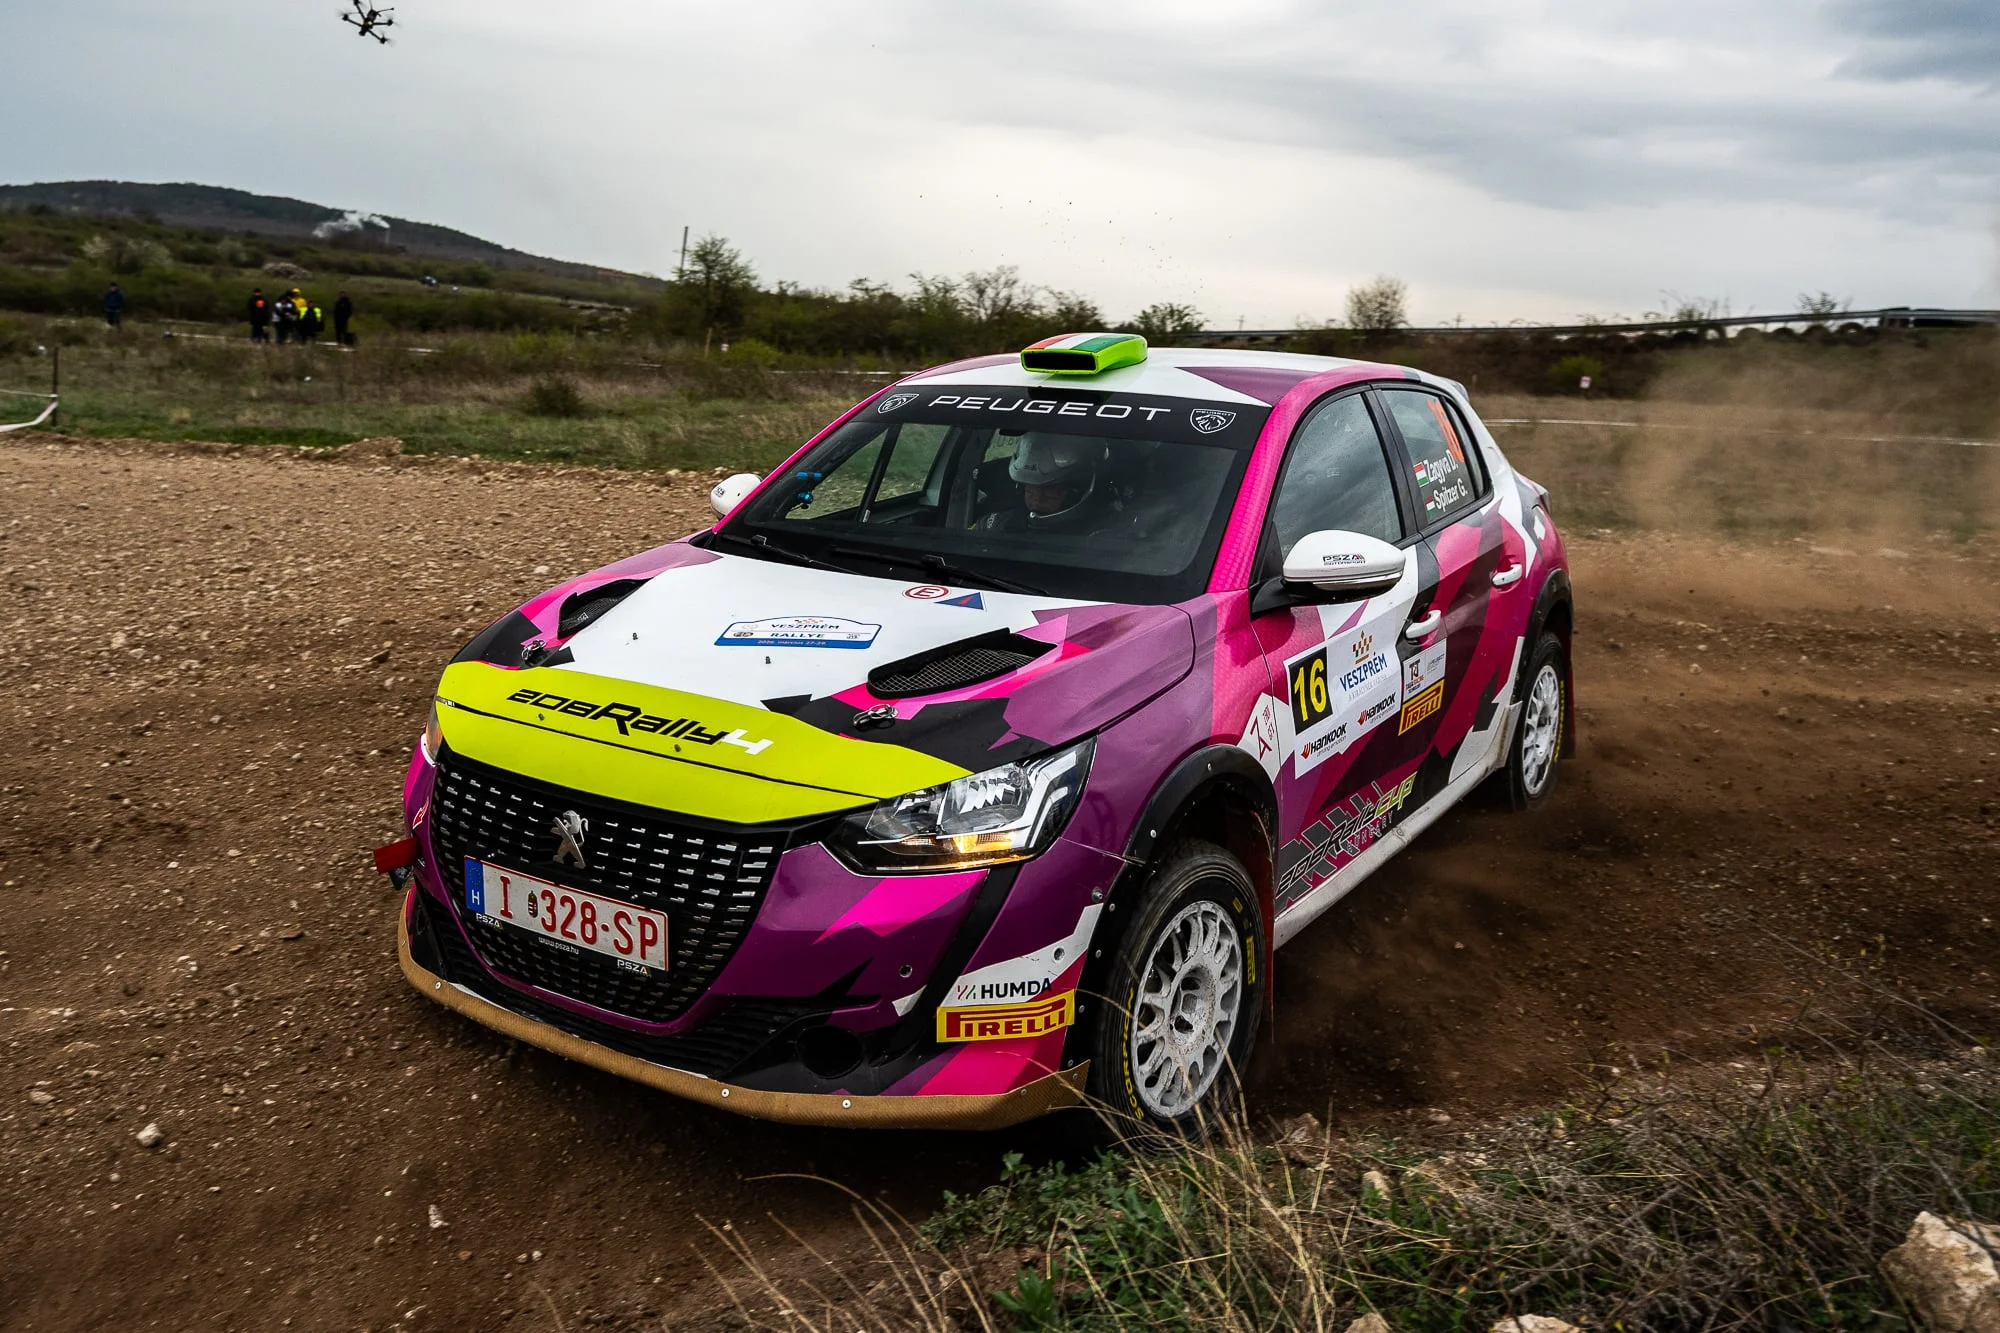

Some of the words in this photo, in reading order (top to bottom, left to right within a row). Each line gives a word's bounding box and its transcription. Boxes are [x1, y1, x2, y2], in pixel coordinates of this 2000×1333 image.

[928, 395, 1171, 421] PEUGEOT
[1423, 456, 1449, 484] Zagyva
[1433, 485, 1459, 512] Spitzer
[1457, 478, 1468, 497] G.
[1322, 553, 1363, 562] PSZA
[1339, 651, 1387, 692] VESZPRÉM
[1294, 658, 1327, 721] 16
[1401, 686, 1441, 732] PIRELLI
[471, 889, 480, 906] H
[500, 875, 513, 919] I
[475, 912, 501, 928] PSZA
[538, 936, 580, 955] www.psza.hu
[617, 959, 649, 976] PSZA
[980, 978, 1052, 999] HUMDA
[945, 997, 1067, 1038] PIRELLI
